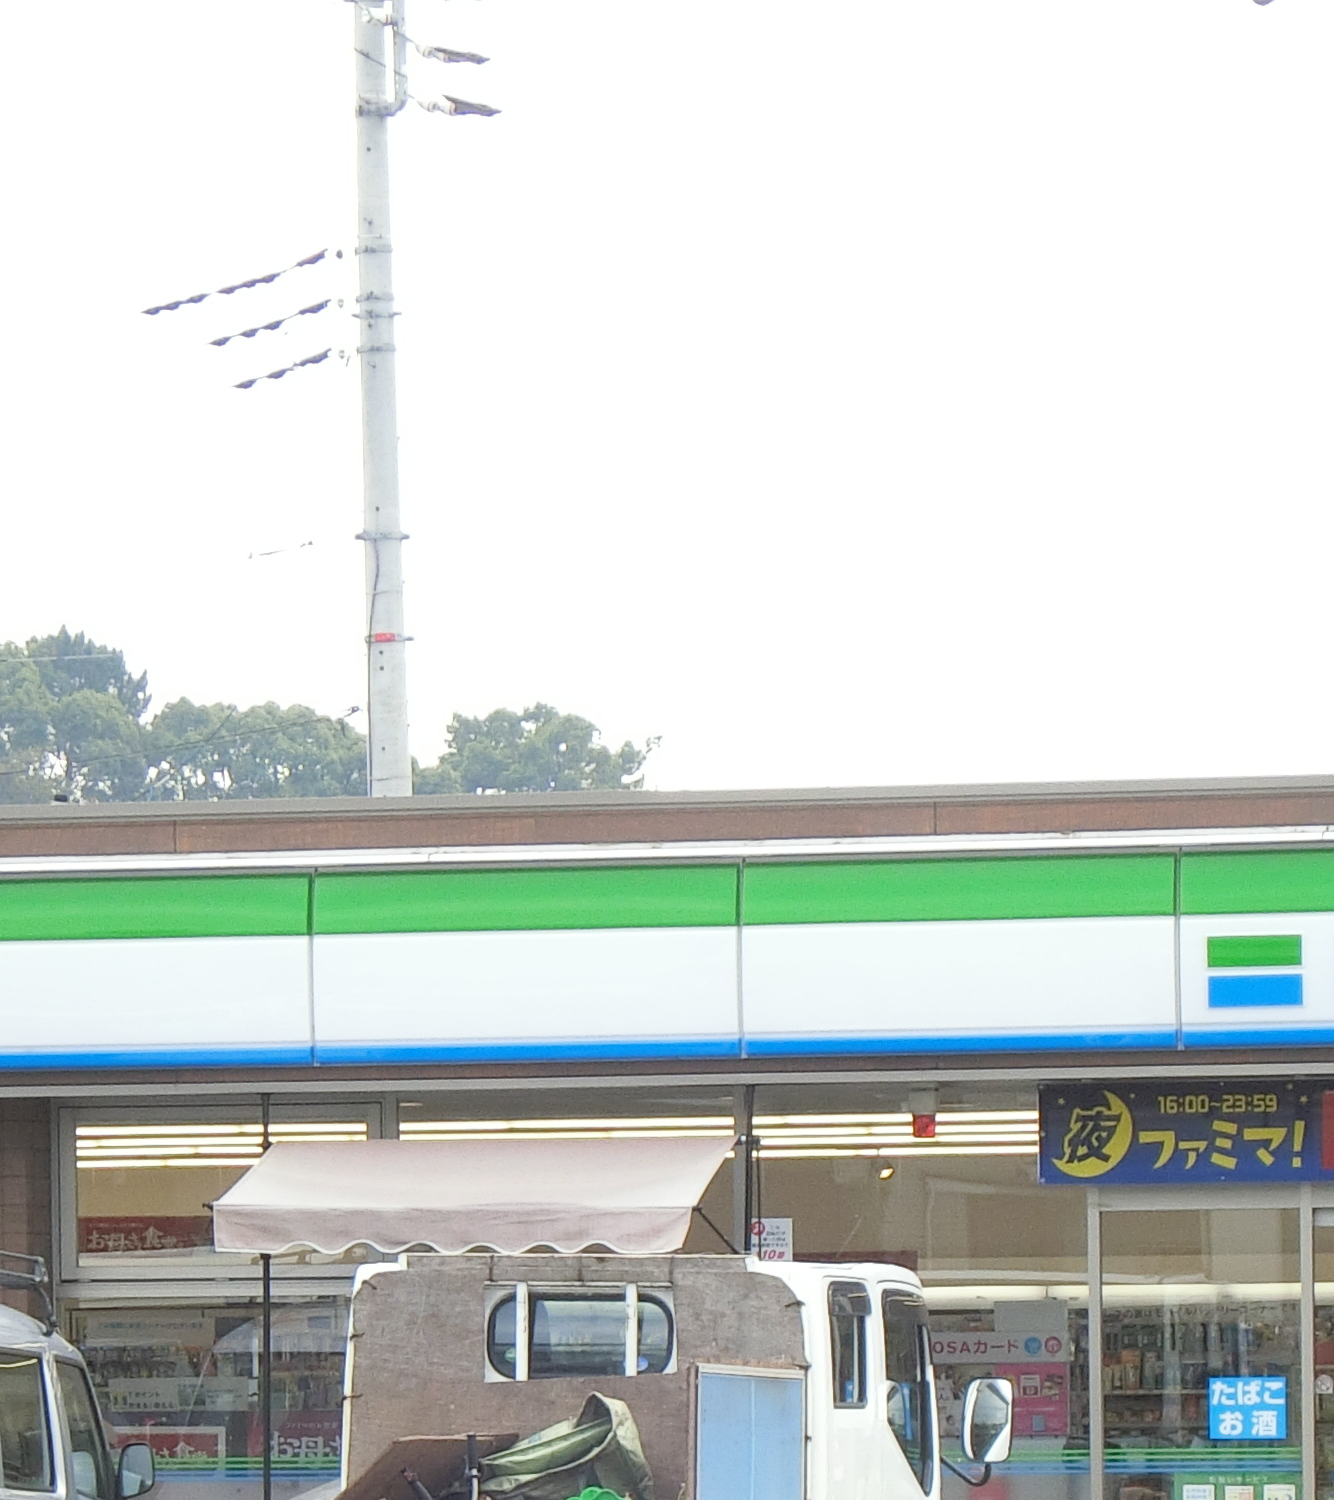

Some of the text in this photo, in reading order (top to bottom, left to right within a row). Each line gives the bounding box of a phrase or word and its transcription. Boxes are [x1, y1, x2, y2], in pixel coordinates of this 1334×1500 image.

[1212, 1381, 1285, 1406] たばこ
[1218, 1410, 1278, 1437] お酒
